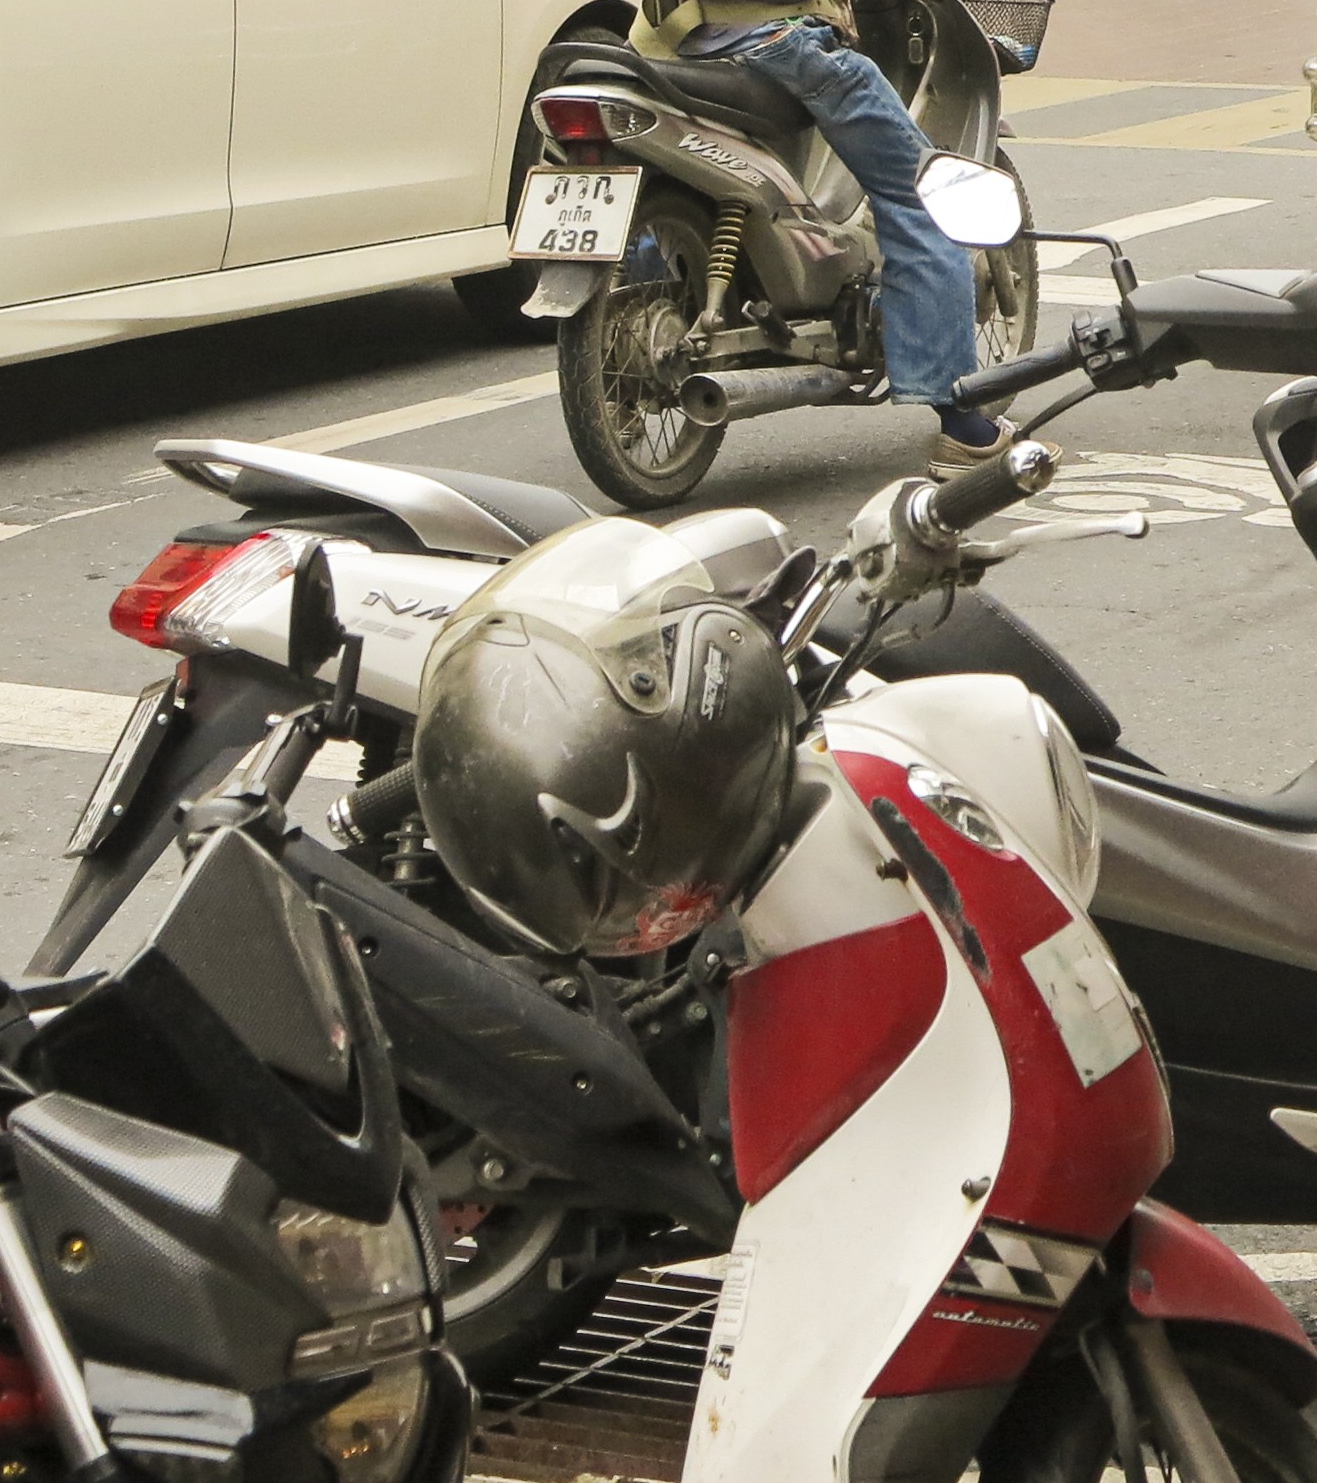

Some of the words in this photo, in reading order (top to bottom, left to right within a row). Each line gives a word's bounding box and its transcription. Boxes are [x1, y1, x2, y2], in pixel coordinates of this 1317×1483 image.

[678, 132, 749, 170] Wave
[557, 205, 592, 226] ภูเก็ต
[538, 229, 598, 253] 438
[932, 1310, 1041, 1331] automatic
